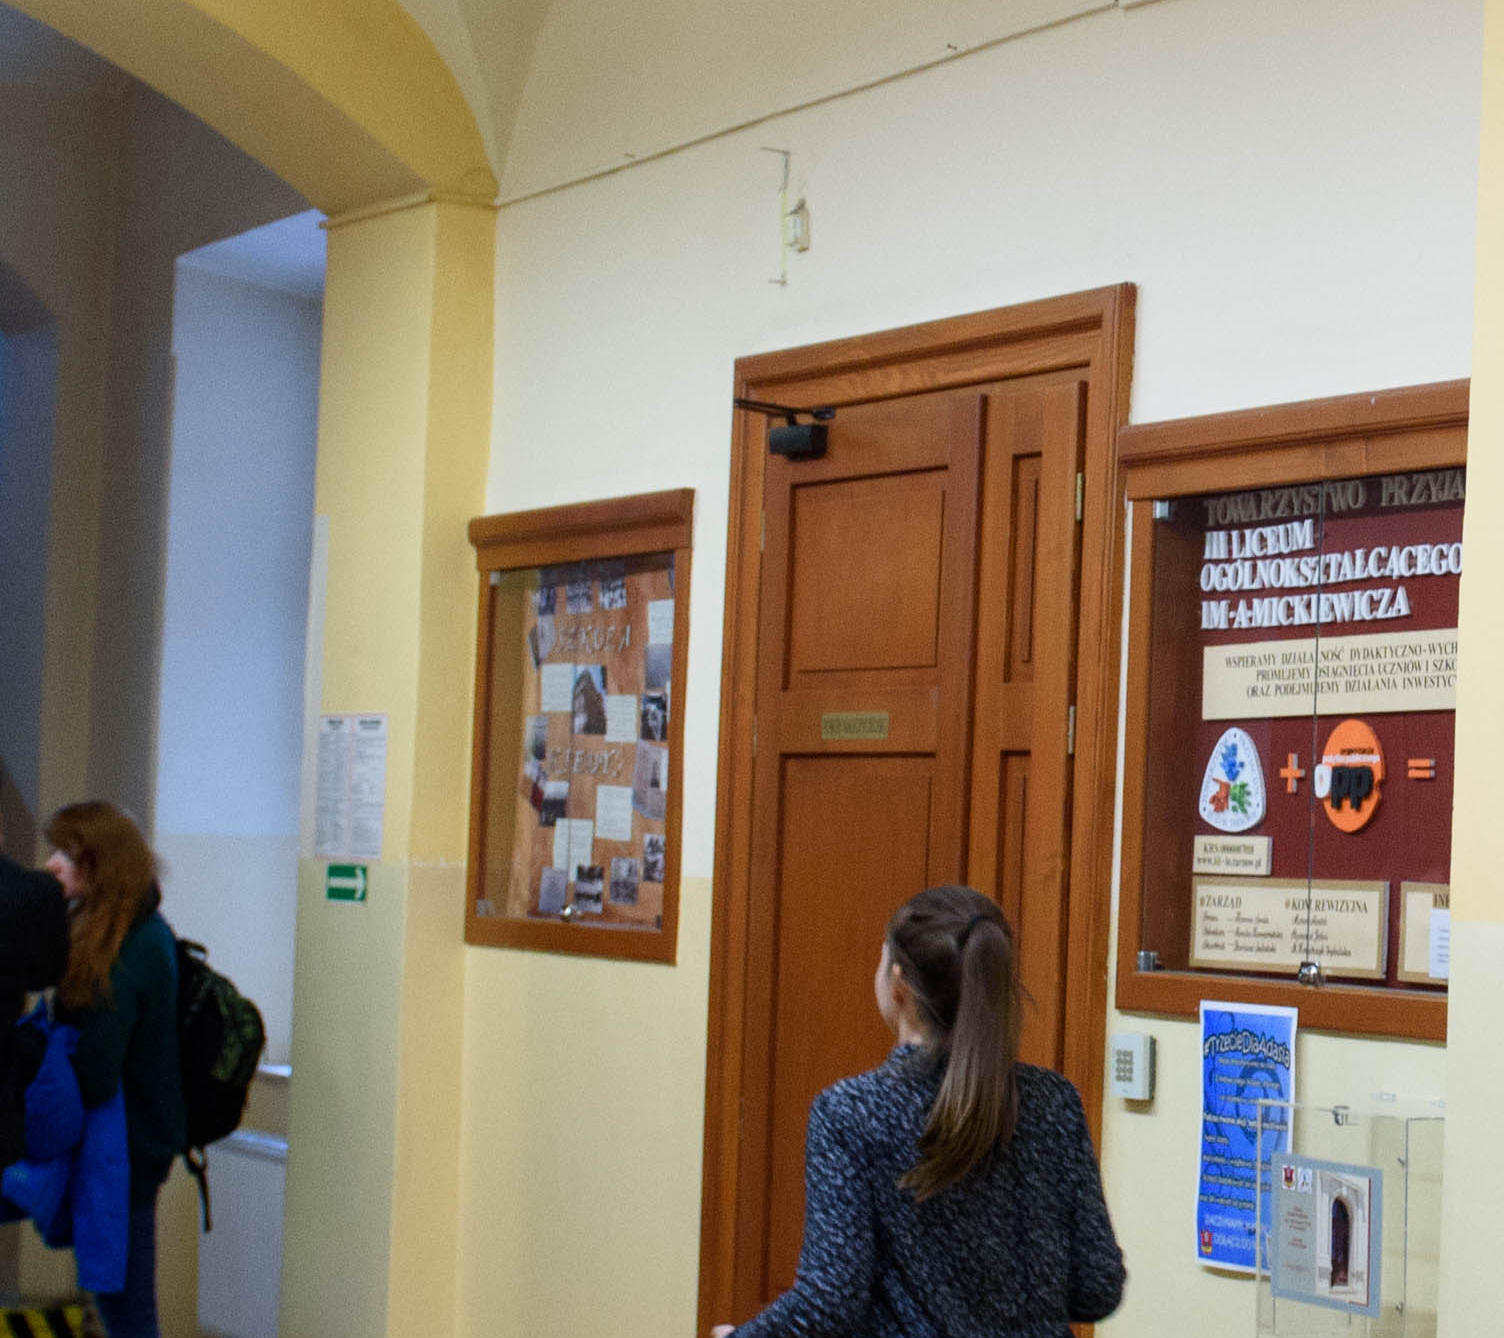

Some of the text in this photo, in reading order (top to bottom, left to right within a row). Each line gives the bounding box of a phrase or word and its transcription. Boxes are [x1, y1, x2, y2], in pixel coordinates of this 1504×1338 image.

[1204, 480, 1366, 527] TOWARZYSTWO
[1203, 518, 1316, 559] III LICEUM
[1199, 542, 1463, 593] OGÓLNOKSZTAŁCĄCEGO
[1205, 895, 1242, 910] ZARZĄD
